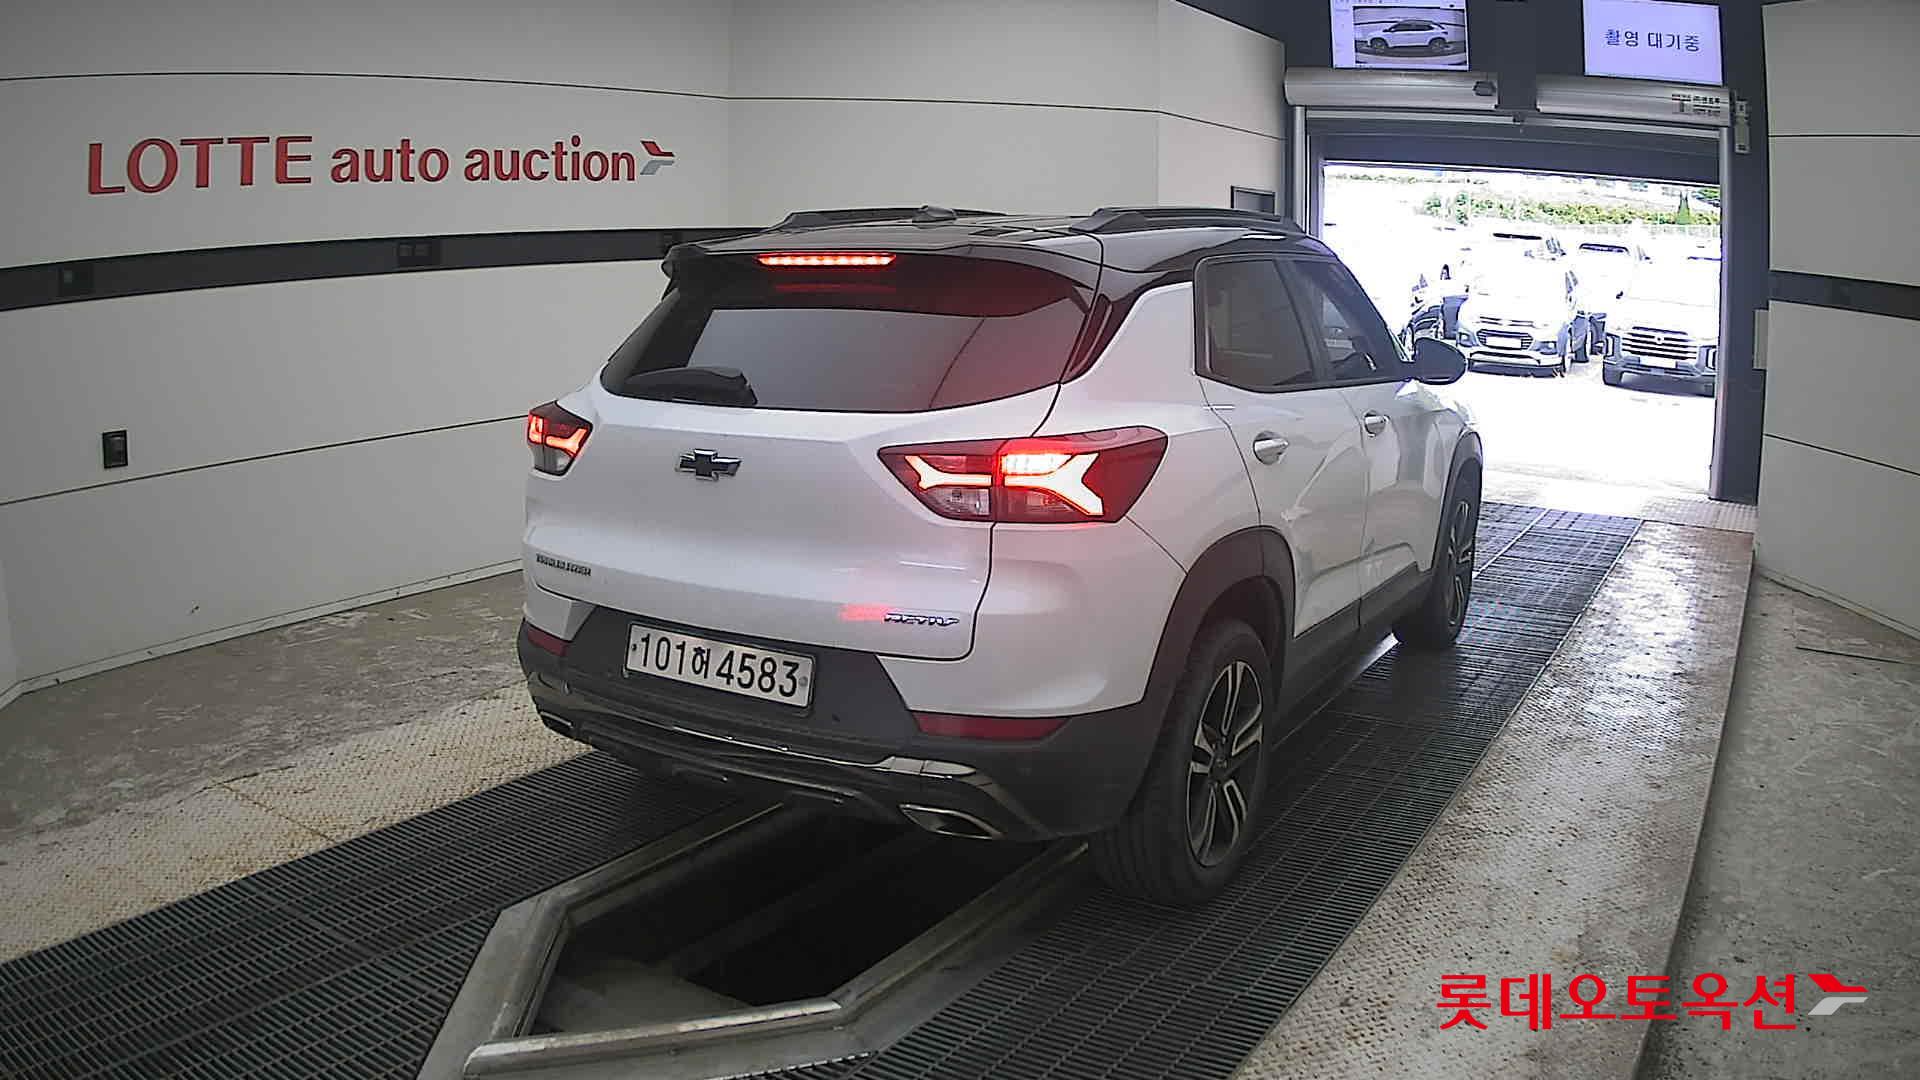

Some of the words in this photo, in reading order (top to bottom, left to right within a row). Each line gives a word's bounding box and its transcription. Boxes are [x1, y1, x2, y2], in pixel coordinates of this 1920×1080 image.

[1647, 32, 1700, 52] 대기중
[88, 135, 313, 195] LOTTE
[330, 138, 449, 183] auto
[463, 135, 636, 182] auction
